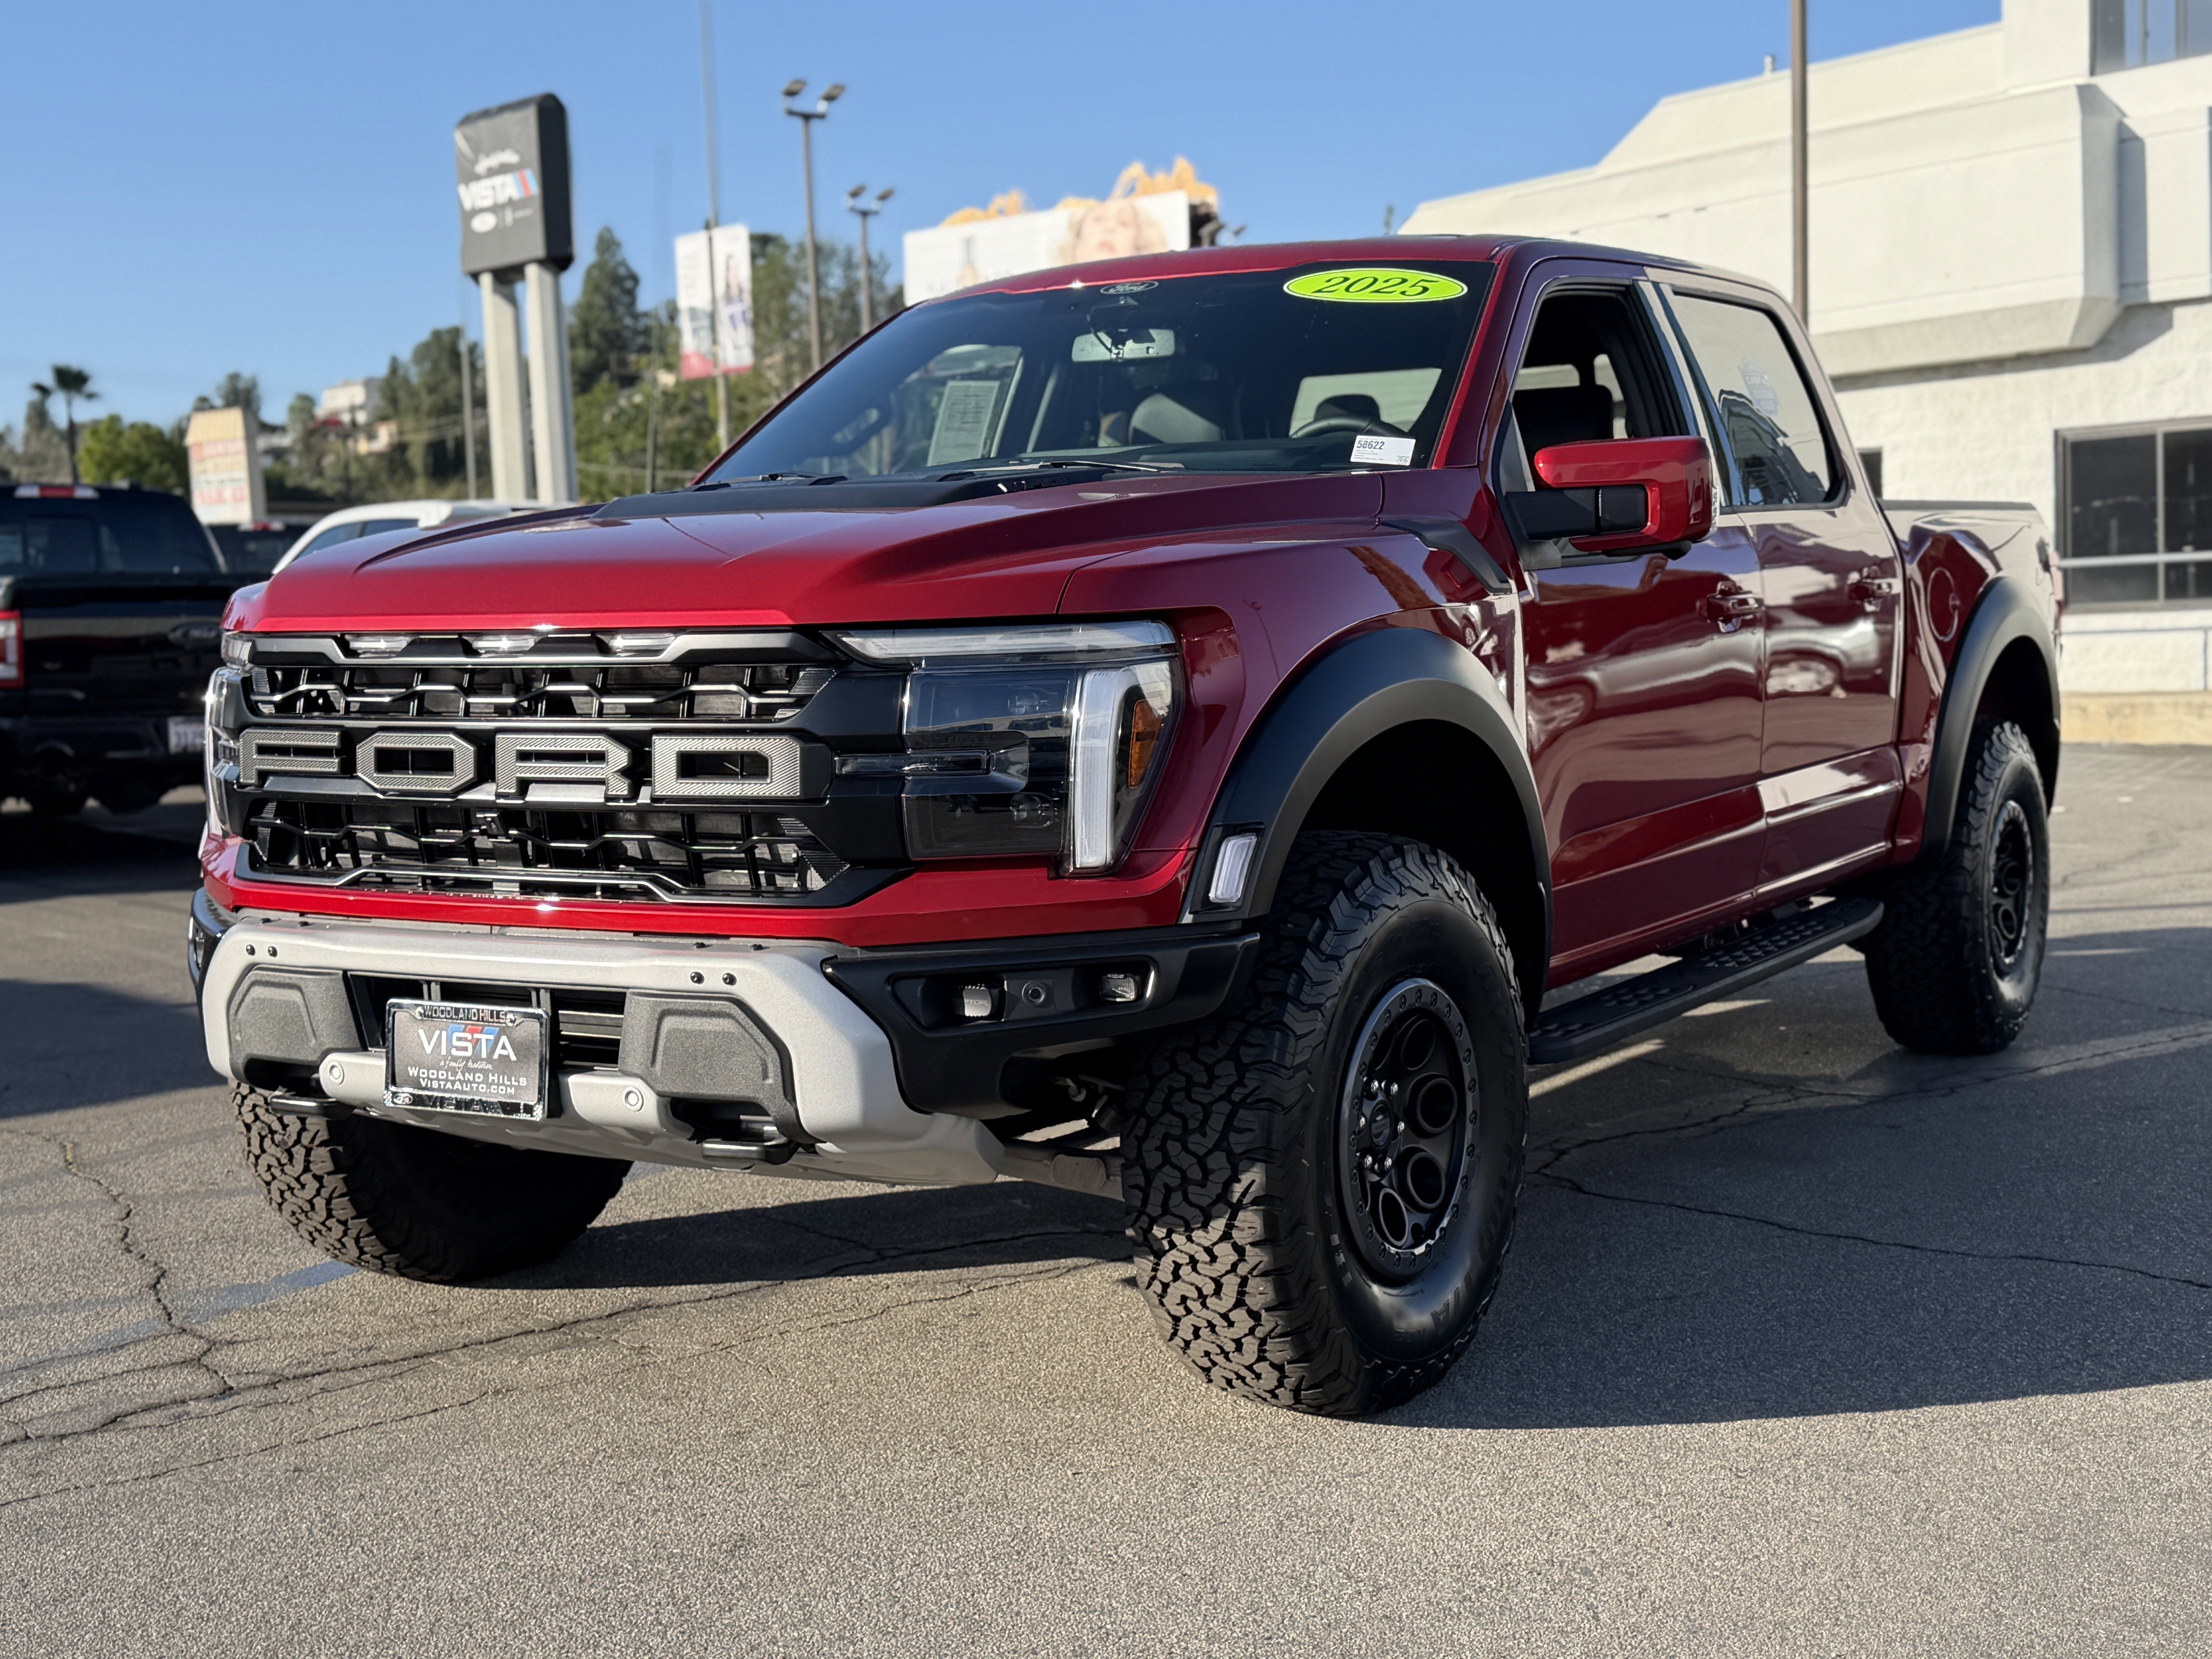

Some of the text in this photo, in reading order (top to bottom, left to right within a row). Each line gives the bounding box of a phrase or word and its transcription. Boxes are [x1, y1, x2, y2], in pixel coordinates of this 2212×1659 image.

[1311, 276, 1441, 297] 2025
[1357, 440, 1385, 450] 58622
[238, 726, 802, 797] FORD
[424, 1005, 506, 1023] WOODLAND HILLS
[418, 1028, 517, 1061] VISTA
[408, 1066, 527, 1086] WOODLAND HILLS
